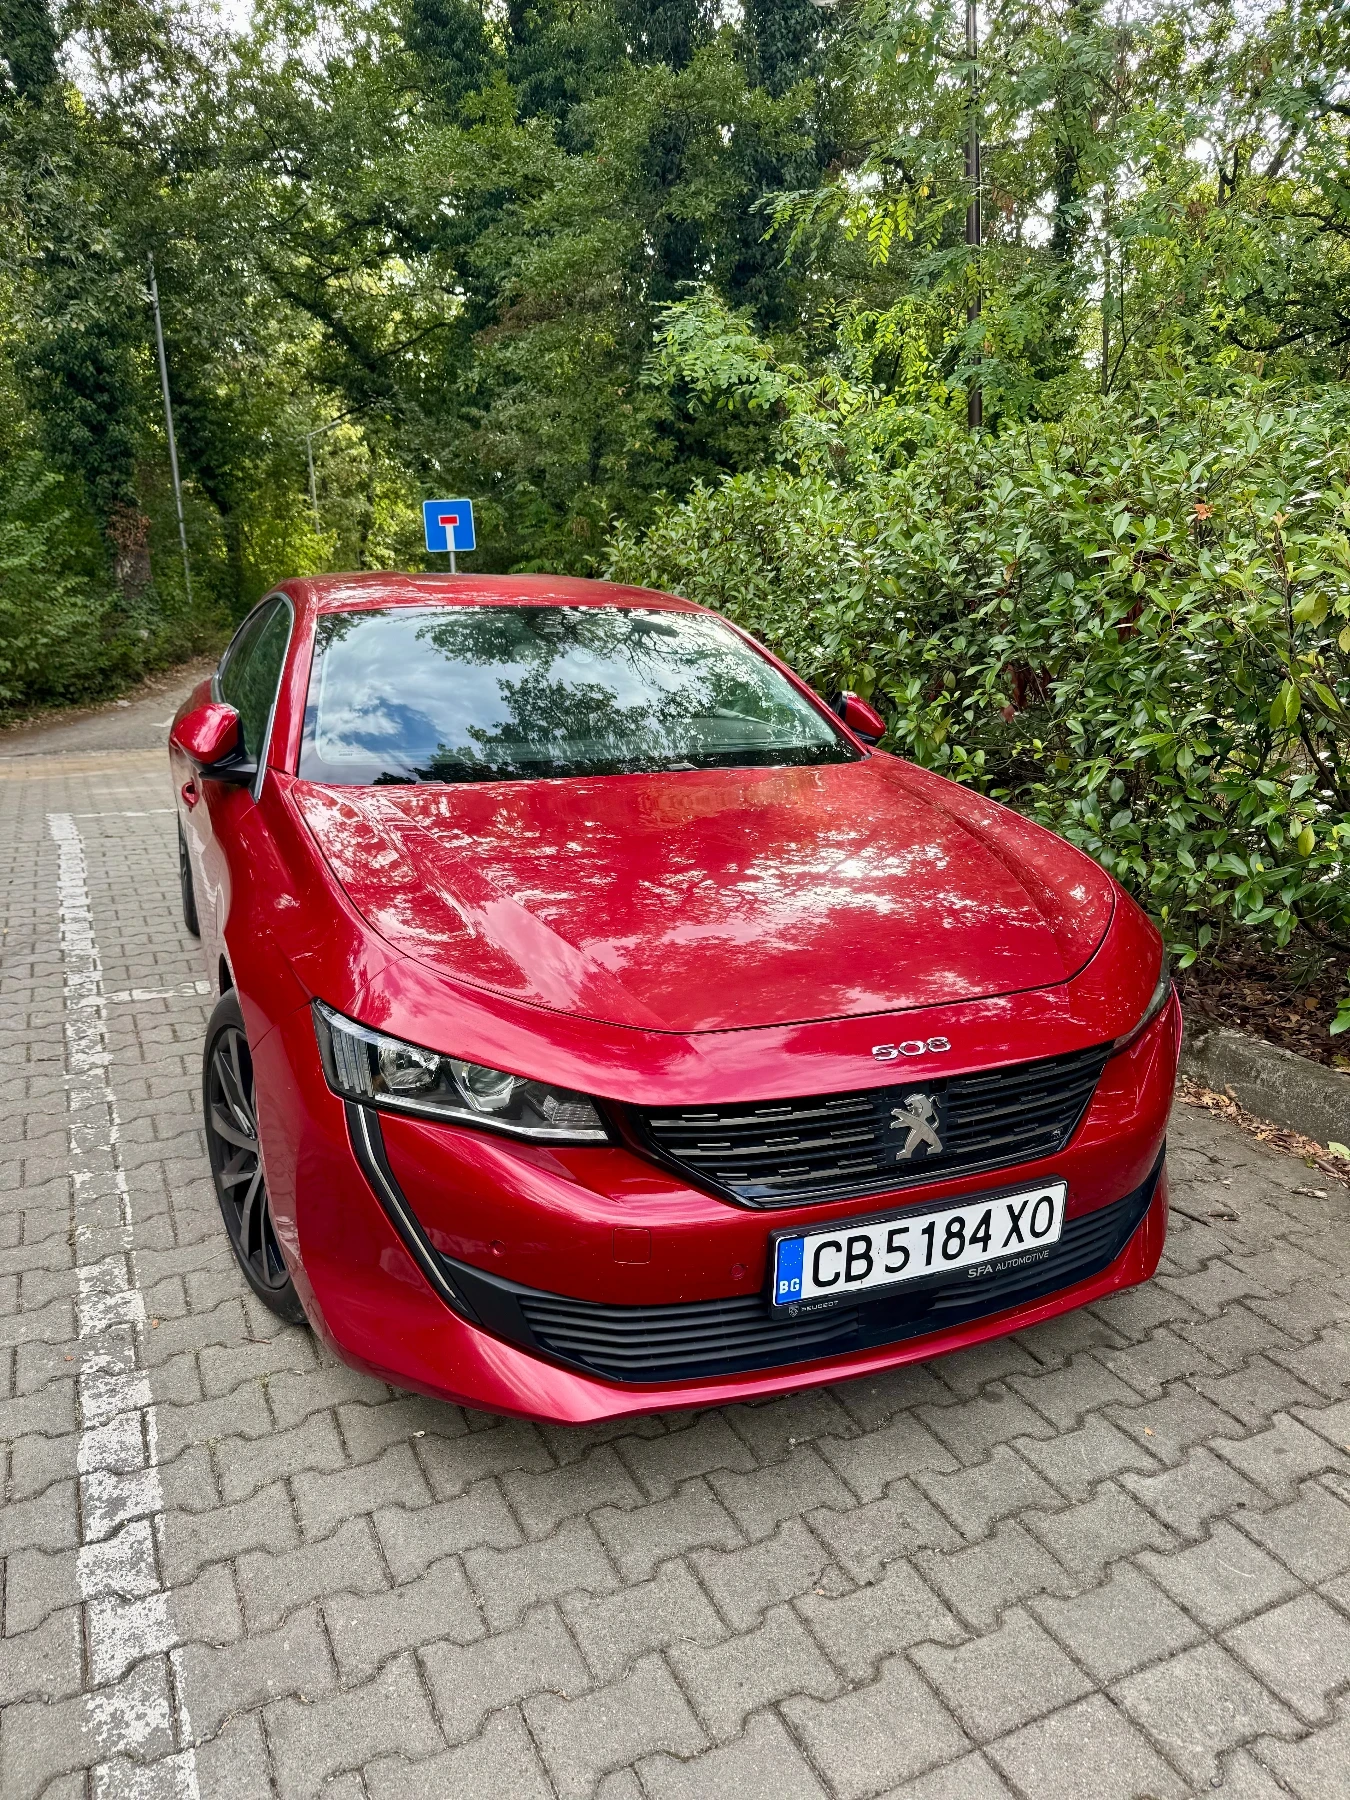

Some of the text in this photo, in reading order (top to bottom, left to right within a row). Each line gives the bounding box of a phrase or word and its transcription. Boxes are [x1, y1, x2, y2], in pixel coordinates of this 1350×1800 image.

[872, 1036, 951, 1061] 508
[812, 1195, 1054, 1288] CB 5184 XO
[967, 1249, 1050, 1278] SFA AUTOMOTIVE
[779, 1278, 800, 1294] BG
